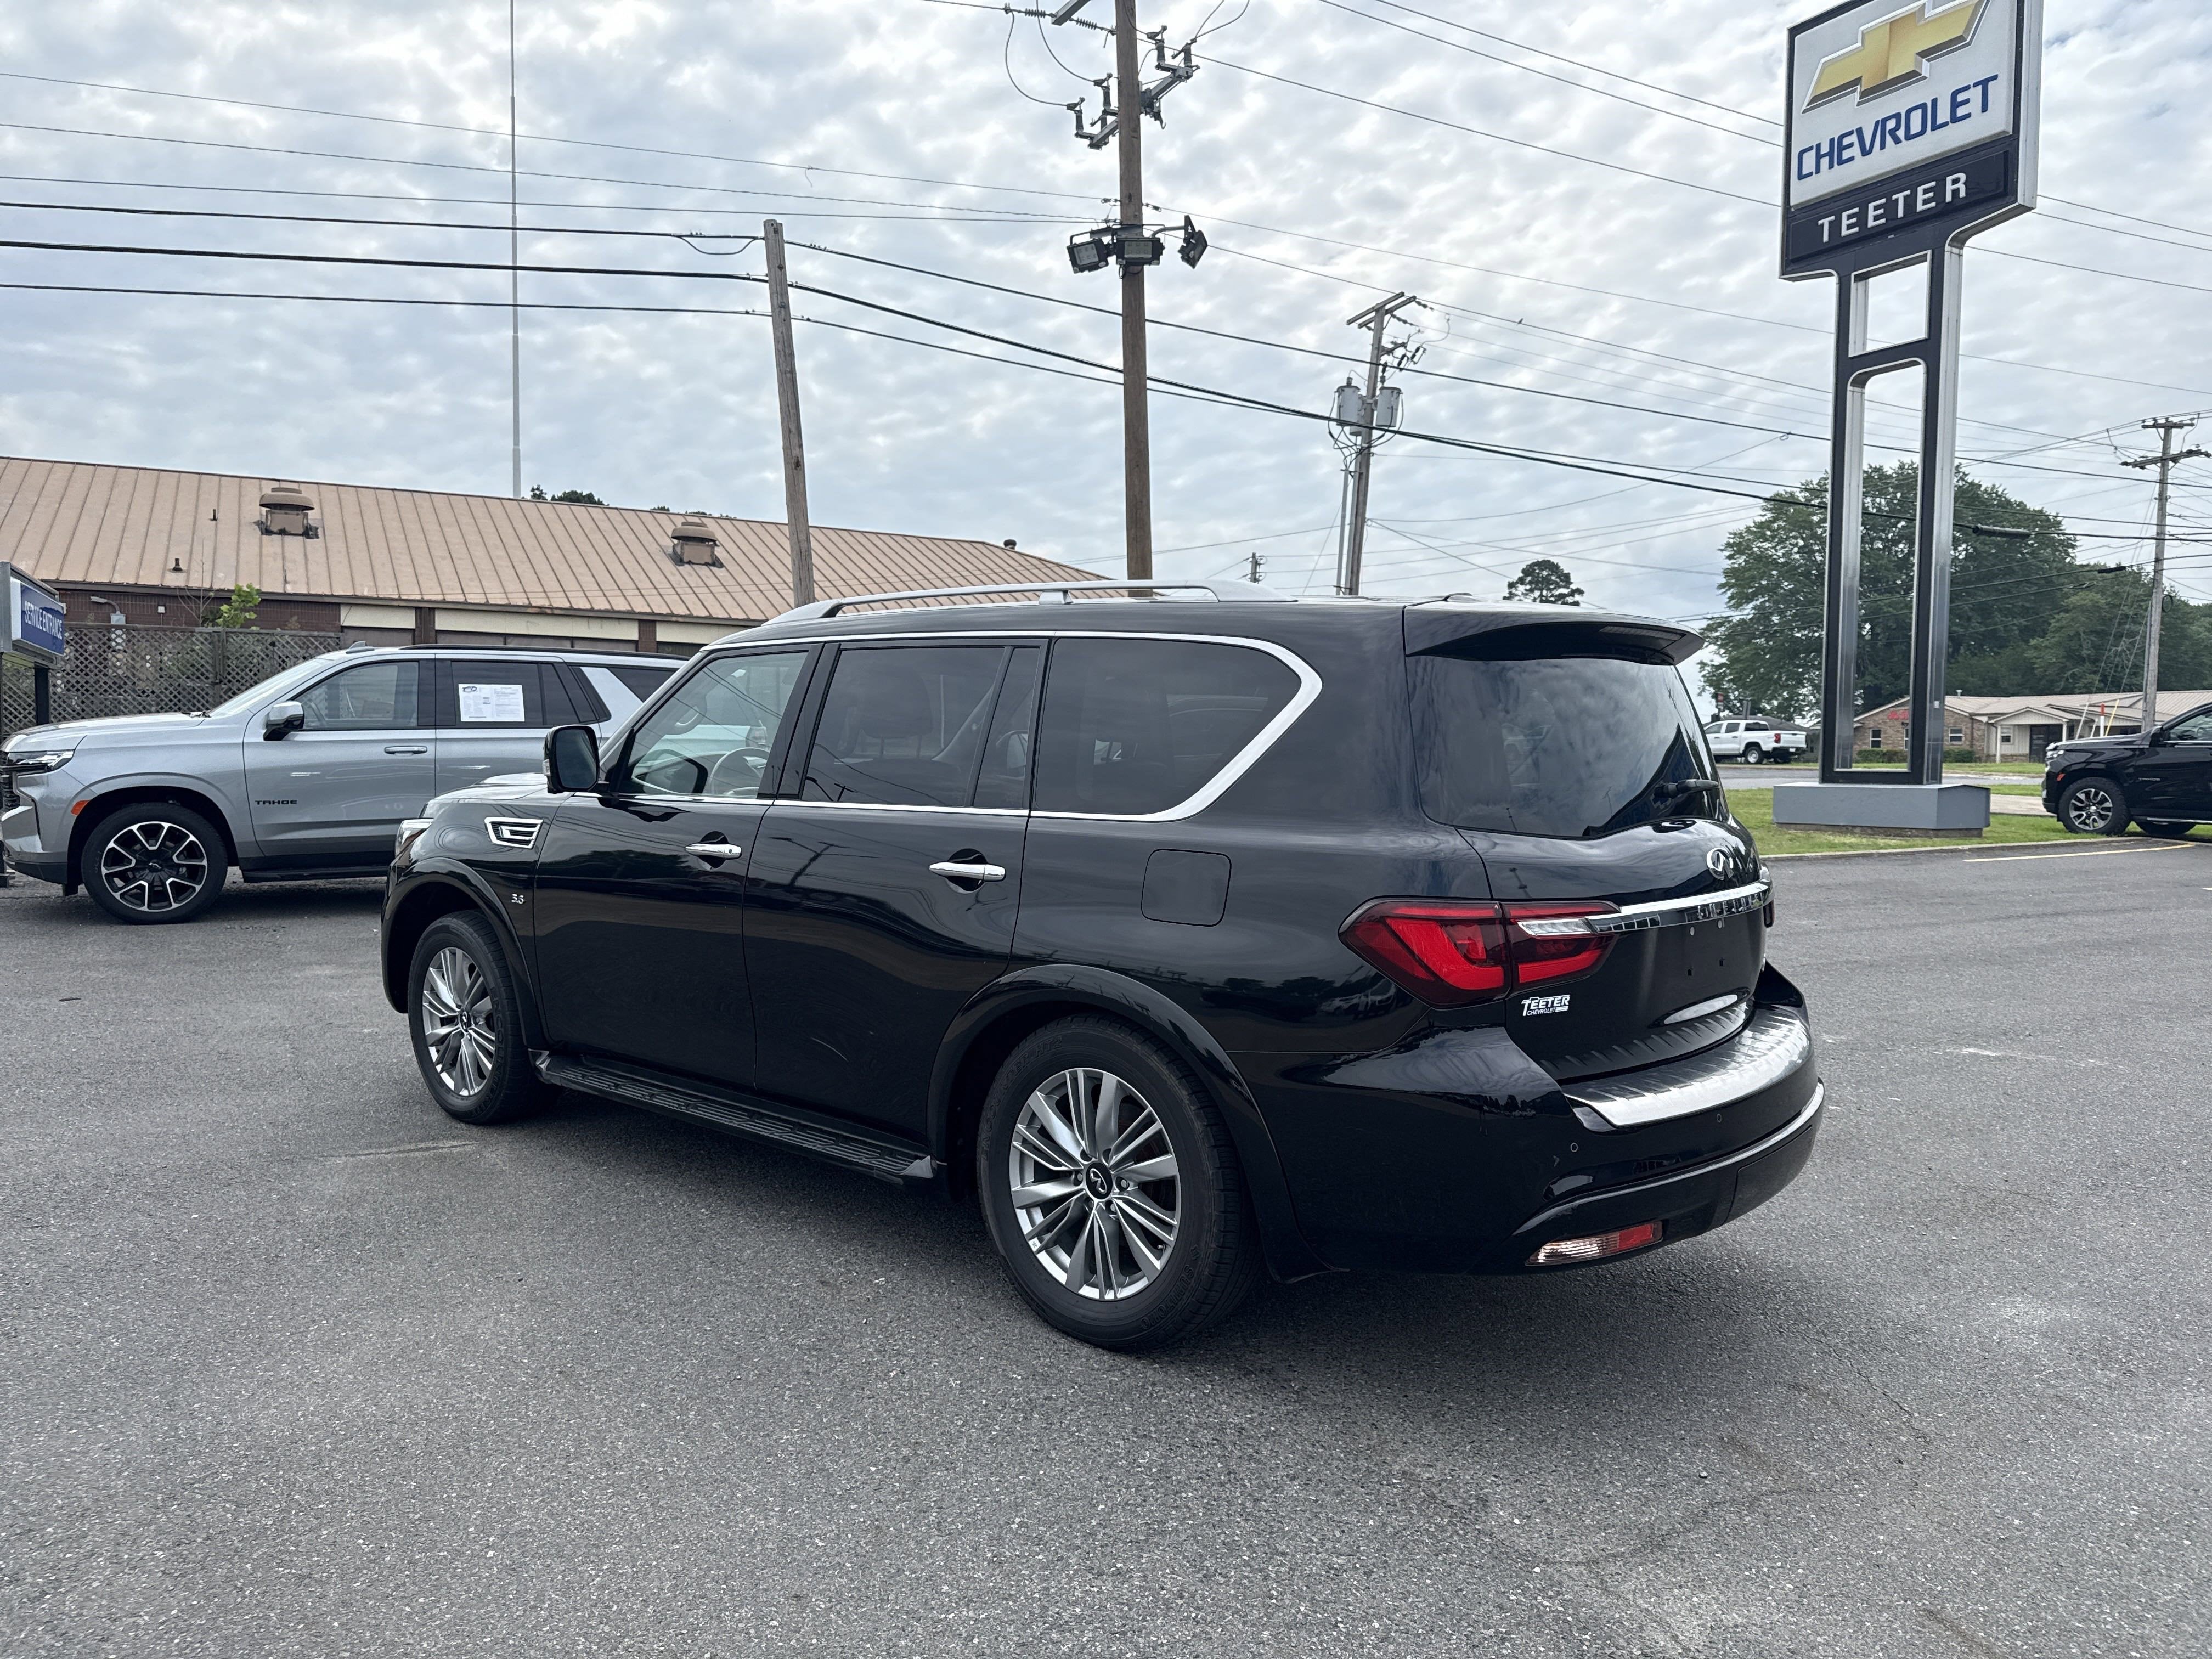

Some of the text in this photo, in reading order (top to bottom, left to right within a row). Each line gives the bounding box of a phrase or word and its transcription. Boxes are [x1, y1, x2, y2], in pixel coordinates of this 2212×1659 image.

[1797, 74, 1999, 181] CHEVROLET
[1818, 172, 1967, 244] TEETER
[25, 601, 63, 640] SERVICE ENTRANCE
[1521, 995, 1571, 1017] TEETER
[1527, 1007, 1556, 1016] CHEVROLET
